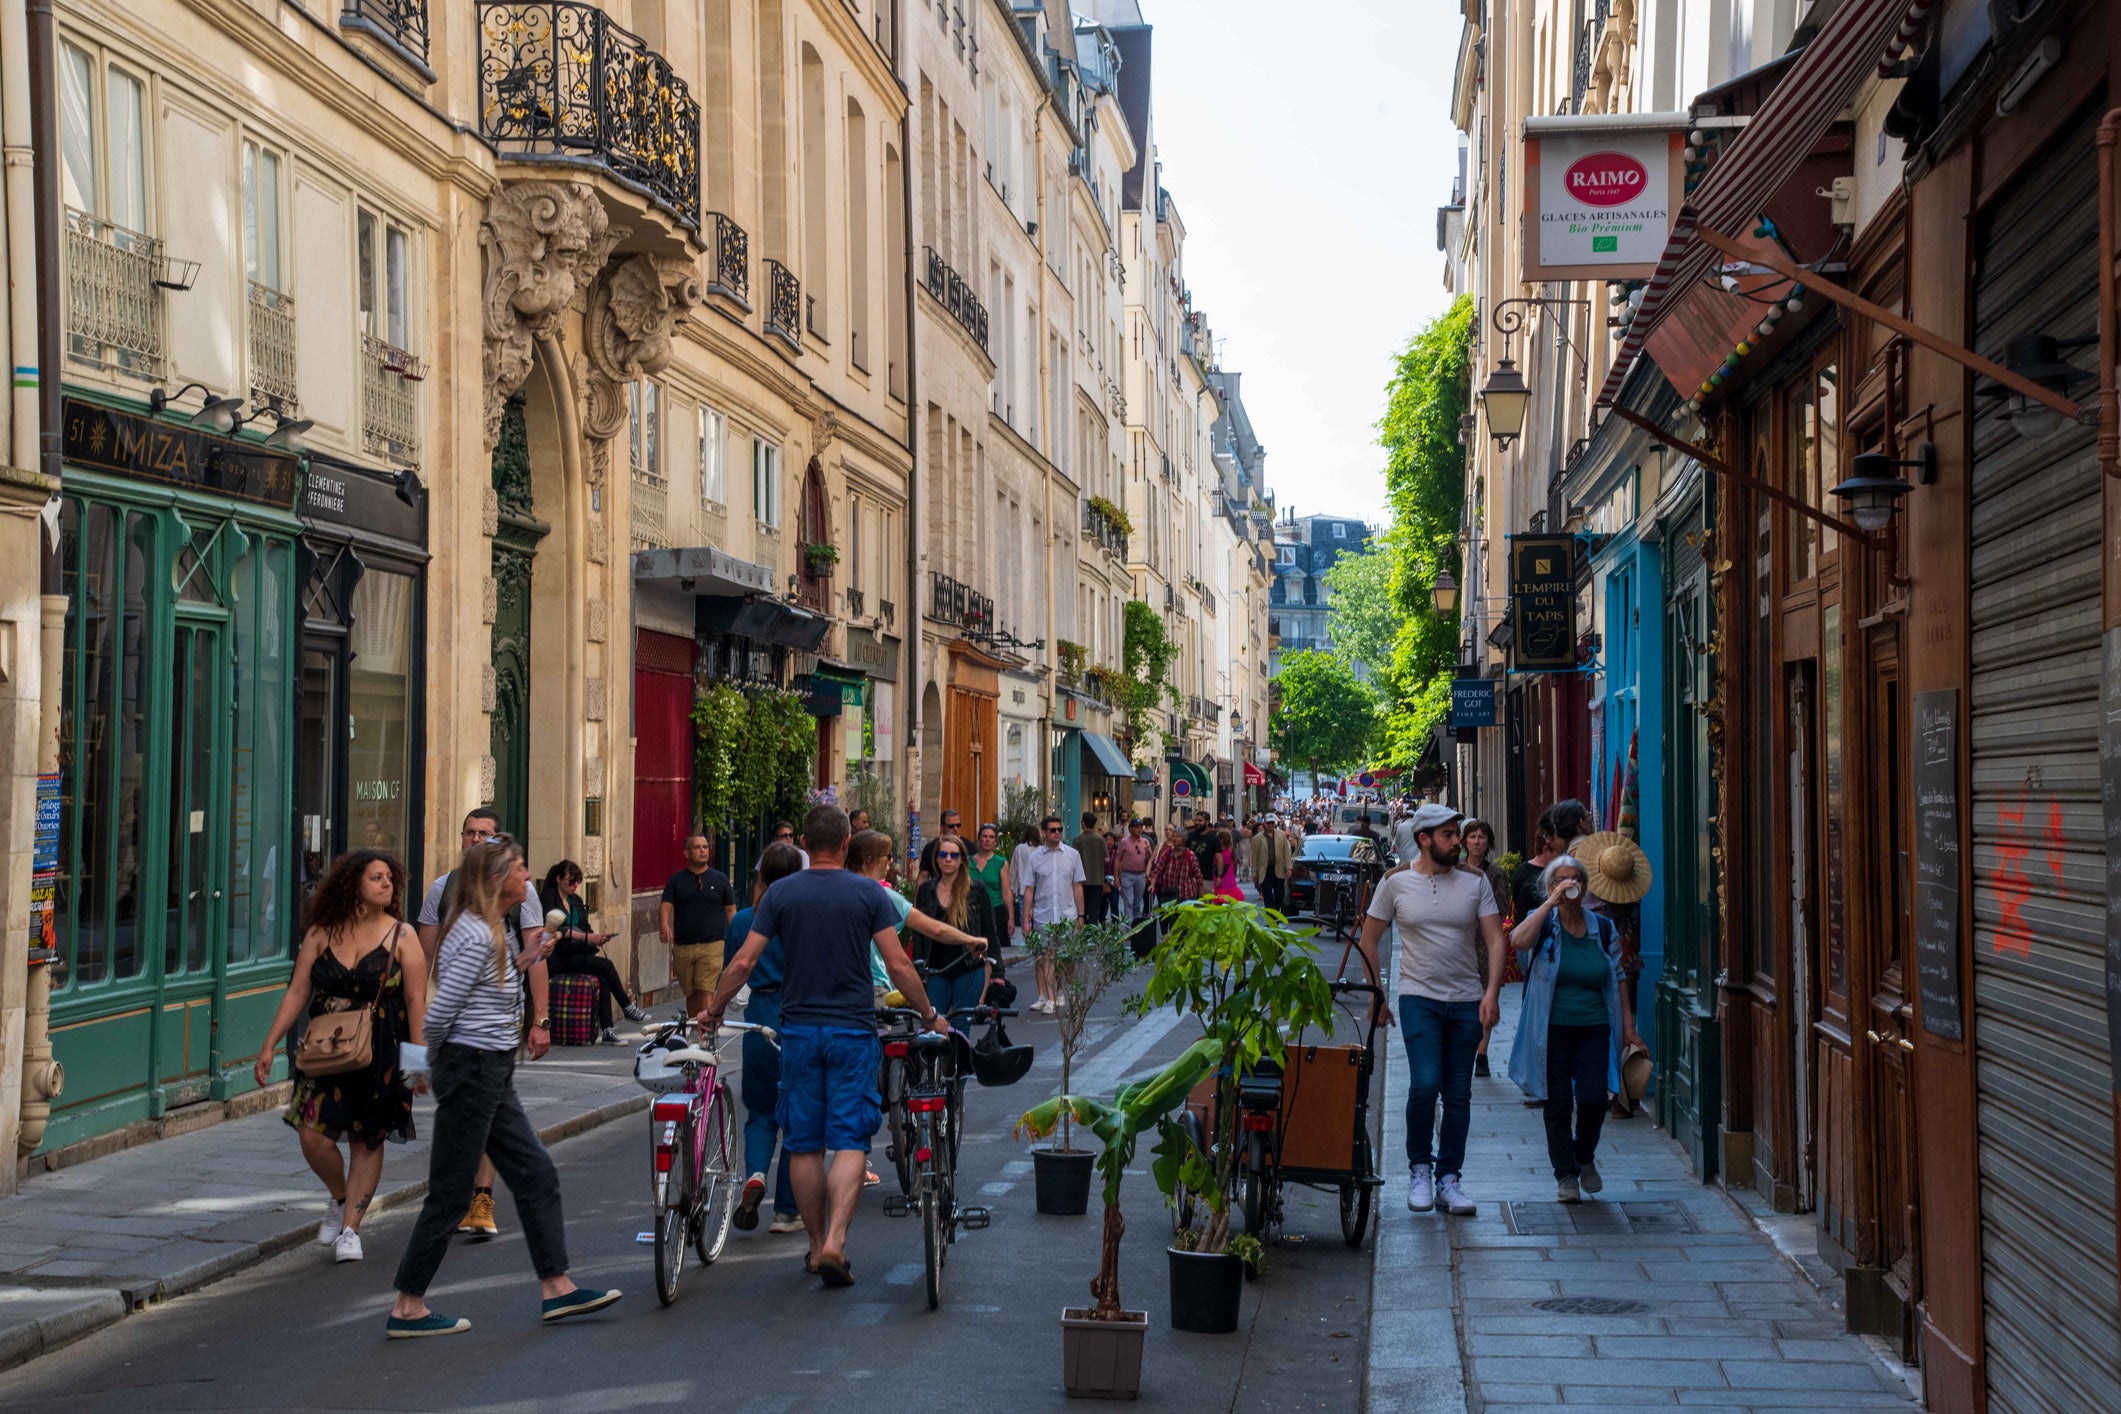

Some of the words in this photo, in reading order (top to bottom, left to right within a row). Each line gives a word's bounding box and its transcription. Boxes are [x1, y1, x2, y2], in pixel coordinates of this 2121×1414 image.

[1572, 169, 1640, 187] RAIMO
[1589, 188, 1606, 196] Paris
[1541, 212, 1586, 223] GLACES
[1589, 209, 1667, 221] ARTISANALES
[1568, 223, 1587, 234] Bio
[70, 418, 85, 443] 51
[113, 423, 189, 476] IMIZA
[281, 471, 292, 491] 51
[1514, 583, 1574, 594] L'EMPIRE
[1534, 596, 1554, 606] DU
[1525, 611, 1565, 622] TAPIS
[1453, 689, 1493, 699] FREDERIC
[1464, 699, 1483, 708] GOT
[356, 780, 389, 801] MAISON
[390, 780, 401, 800] CF
